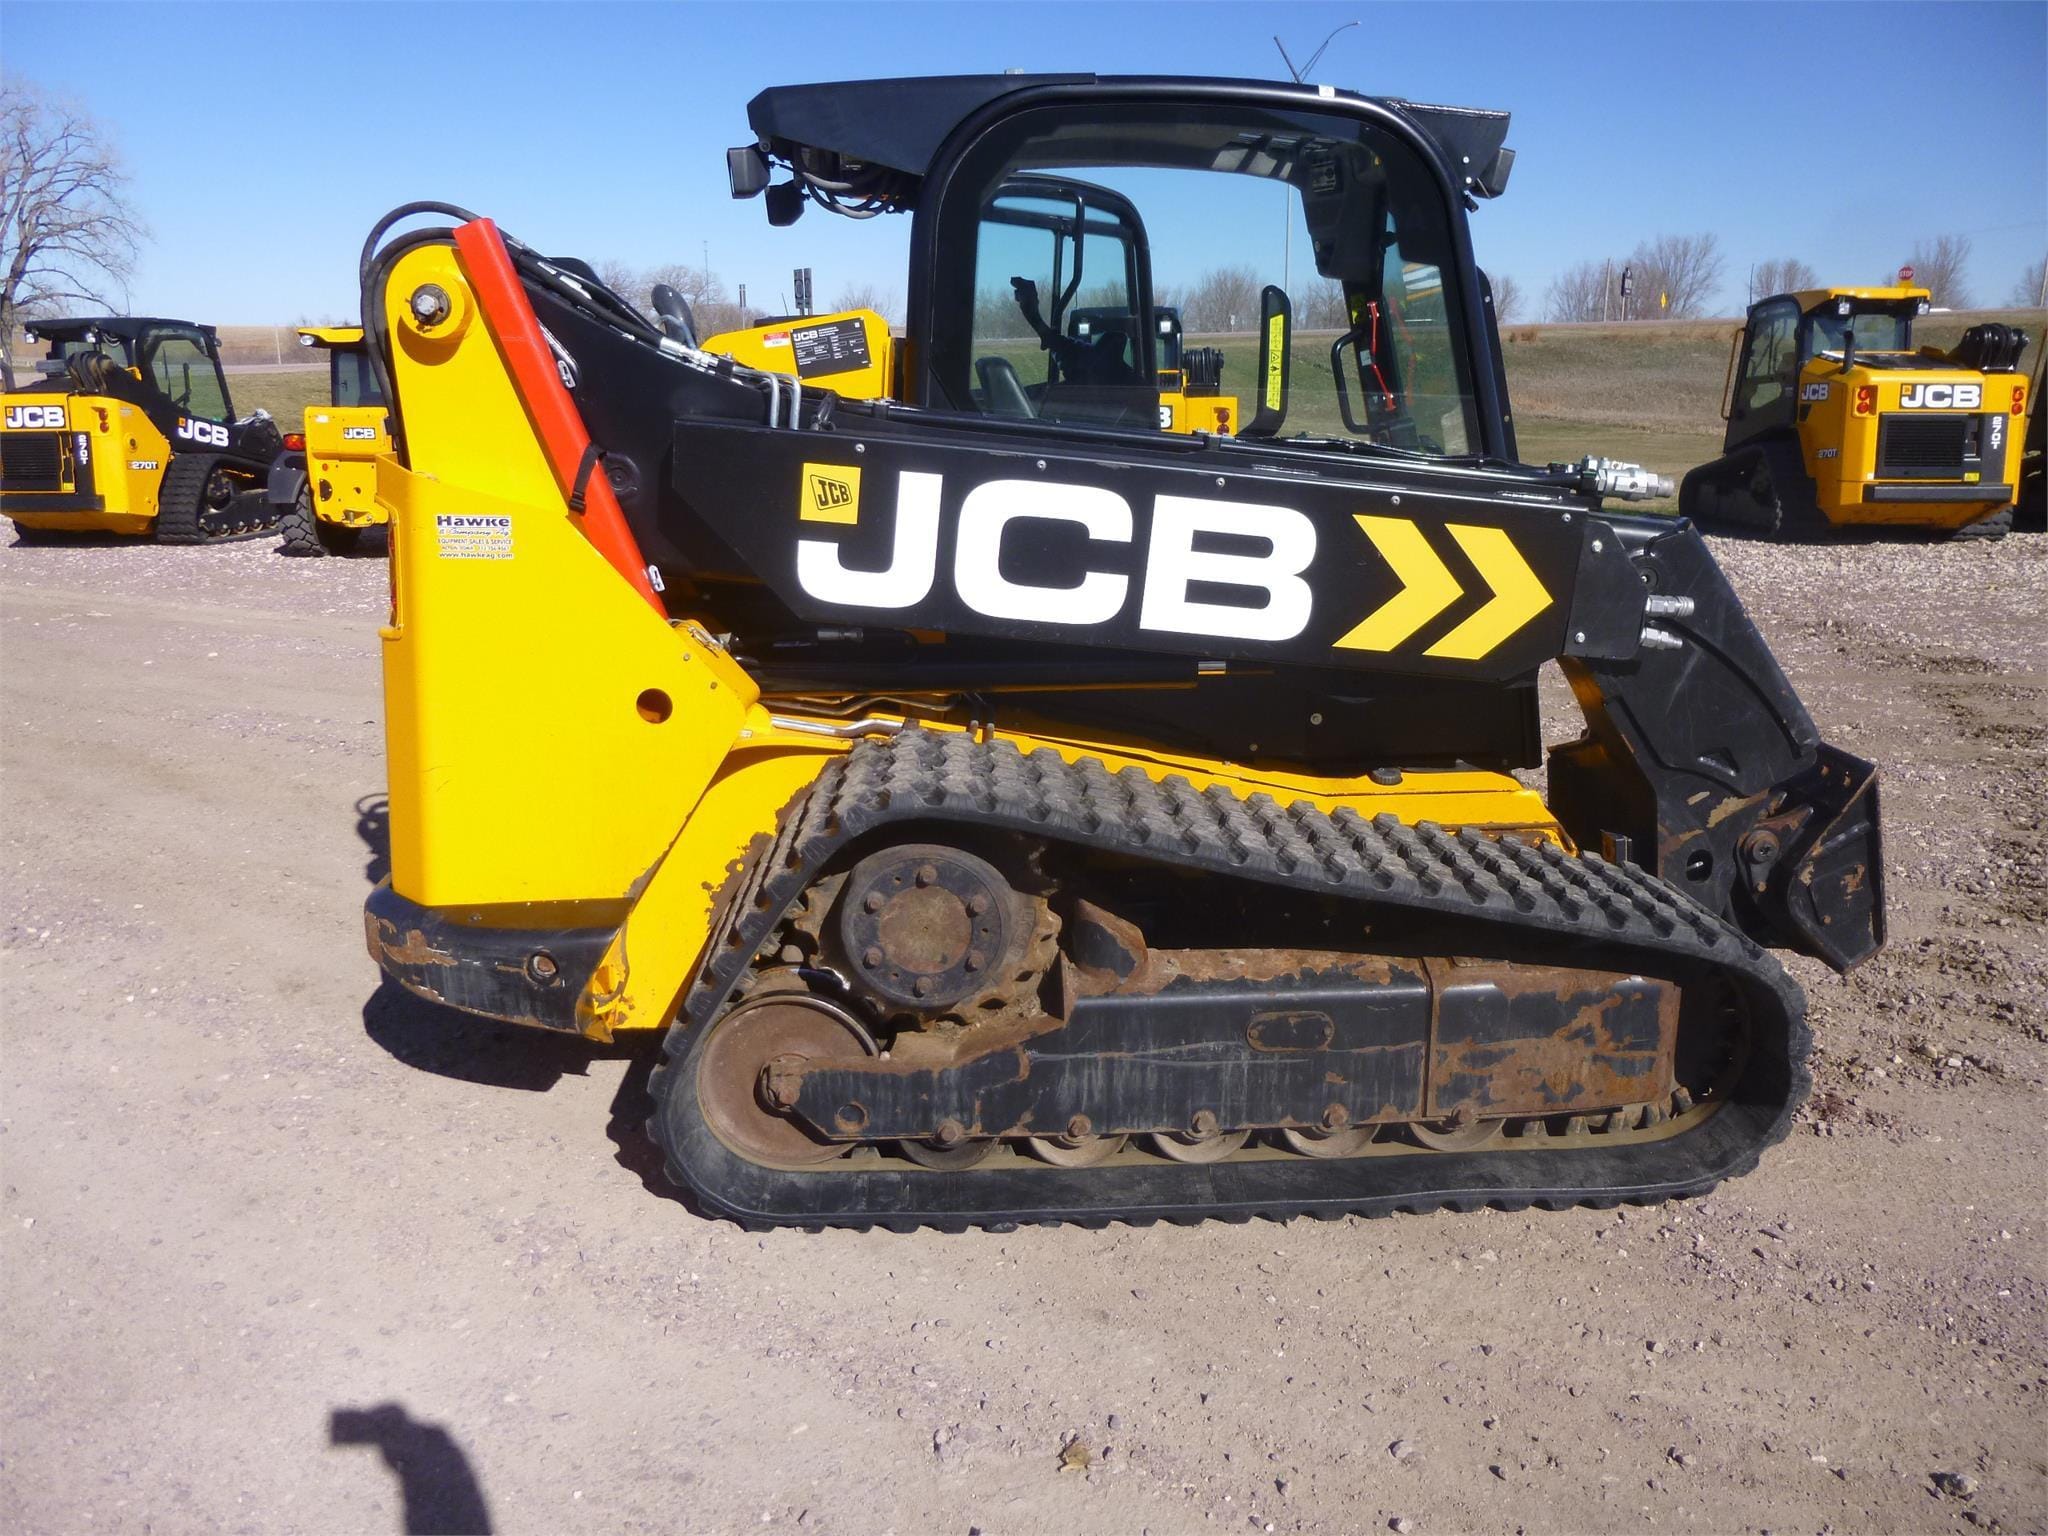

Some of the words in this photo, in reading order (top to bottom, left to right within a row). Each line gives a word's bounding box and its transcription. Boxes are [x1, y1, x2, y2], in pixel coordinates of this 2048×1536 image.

[793, 330, 819, 342] JCB
[1802, 383, 1828, 400] JCB
[1901, 385, 1980, 408] JCB
[6, 406, 65, 428] JCB
[178, 418, 230, 447] JCB
[344, 428, 375, 439] JCB
[1991, 416, 2003, 450] 270T
[78, 434, 89, 465] 270T
[1817, 448, 1837, 458] 270T
[132, 461, 158, 470] 270T
[817, 479, 850, 507] JCB
[436, 515, 510, 527] Hawke
[796, 470, 1318, 642] JCB
